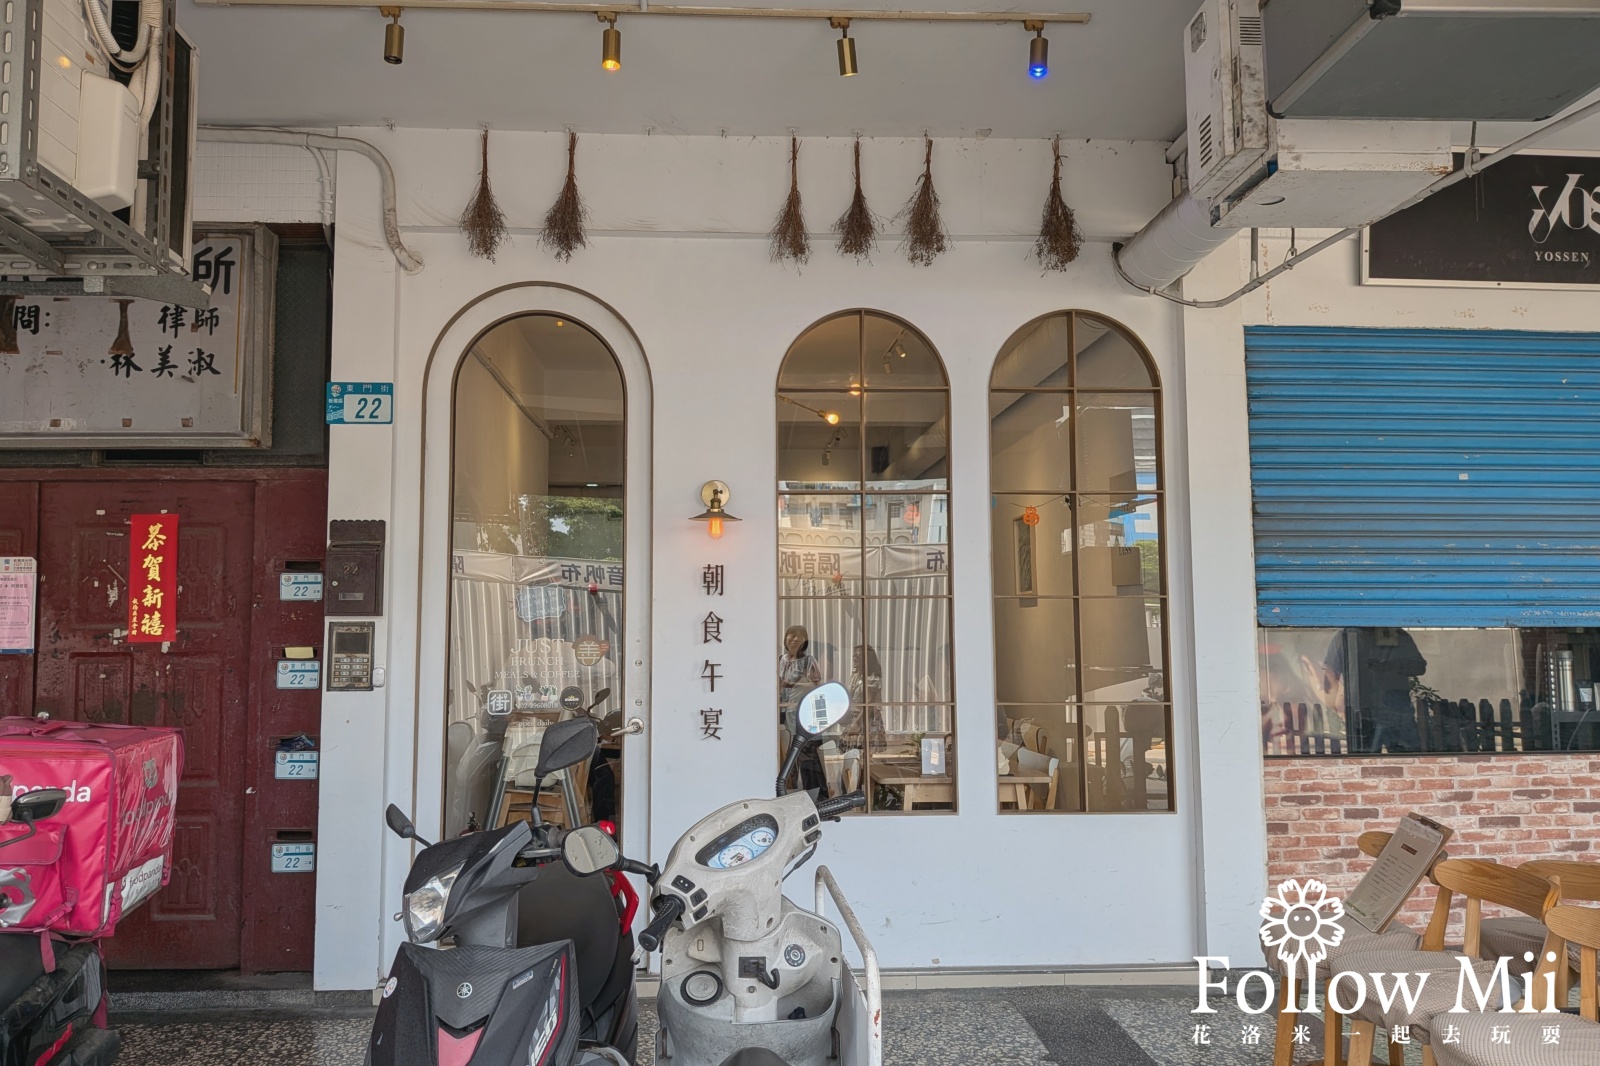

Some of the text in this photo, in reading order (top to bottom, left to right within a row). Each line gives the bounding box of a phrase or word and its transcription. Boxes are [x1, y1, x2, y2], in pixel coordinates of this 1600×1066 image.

[1535, 251, 1589, 262] YOSSEN
[192, 246, 236, 295] 所
[157, 305, 220, 339] 律師
[346, 384, 389, 393] 東門街
[354, 397, 382, 419] 22
[343, 565, 358, 575] 22
[141, 523, 167, 636] 恭賀新禧
[293, 586, 309, 597] 22
[510, 638, 565, 654] JUST
[699, 563, 724, 741] 朝食午宴
[511, 656, 564, 666] BRUNCH
[290, 674, 305, 685] 22
[494, 670, 581, 679] MEALS & COFFEE
[490, 693, 510, 712] 街
[288, 764, 304, 776] 22
[284, 857, 300, 869] 22
